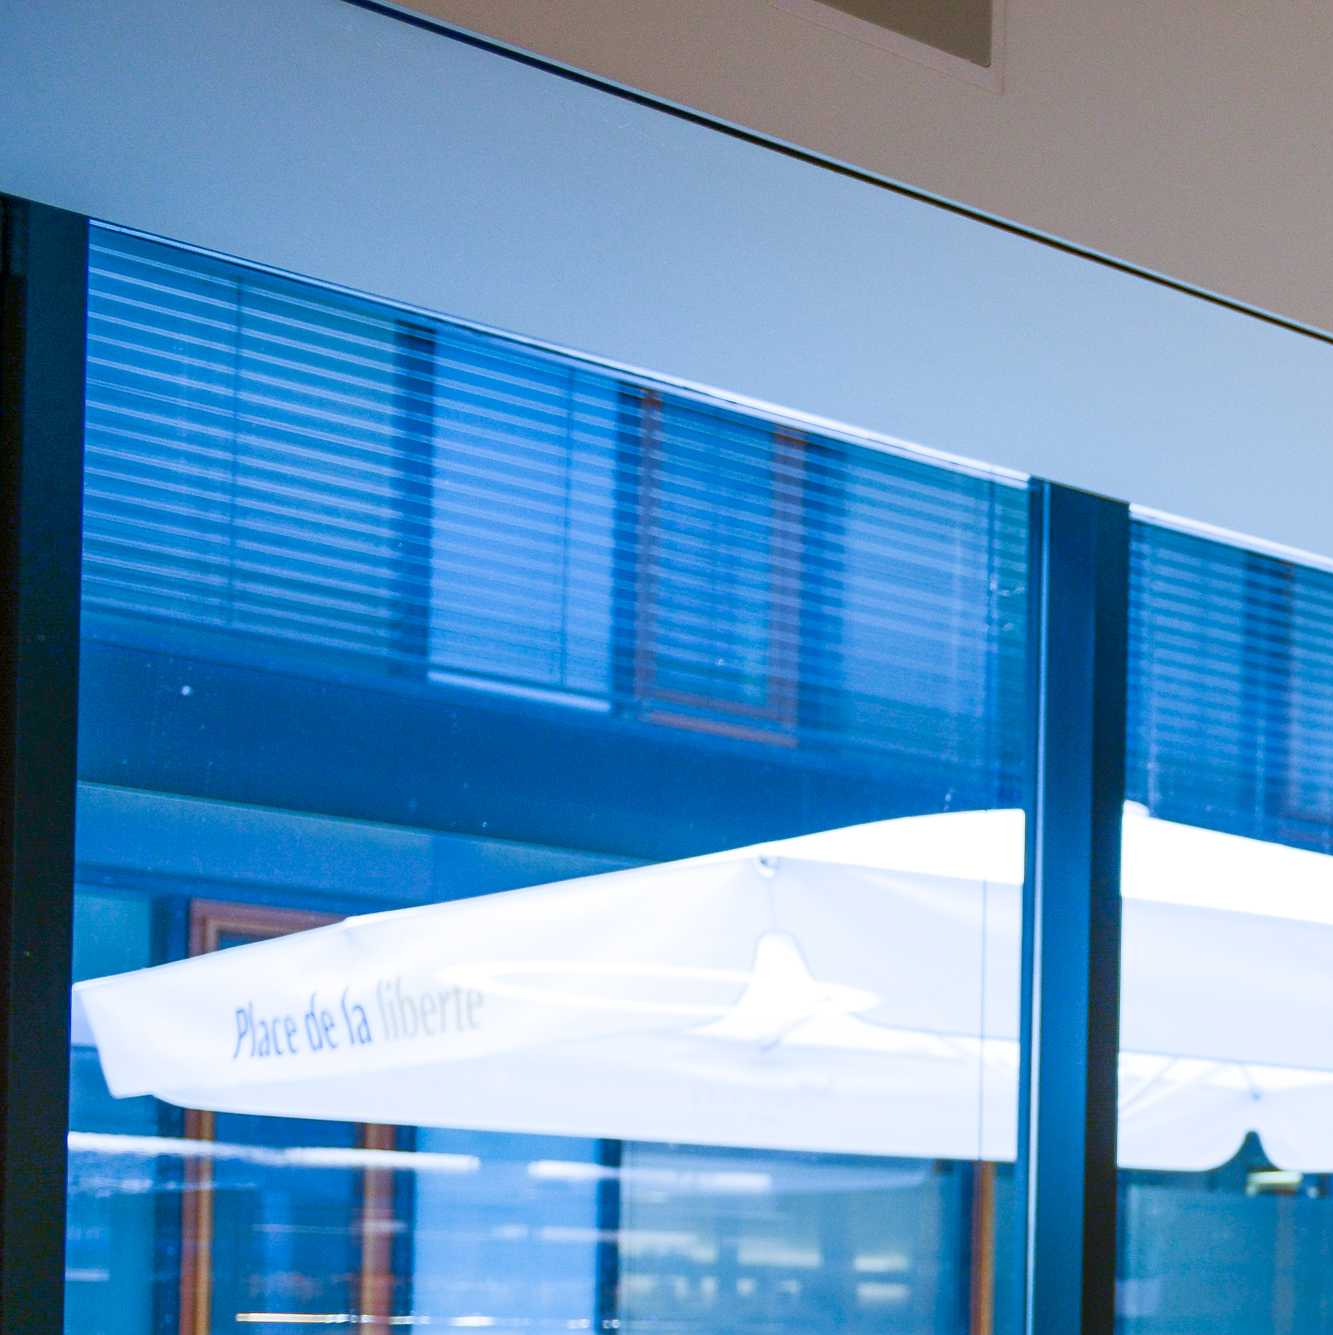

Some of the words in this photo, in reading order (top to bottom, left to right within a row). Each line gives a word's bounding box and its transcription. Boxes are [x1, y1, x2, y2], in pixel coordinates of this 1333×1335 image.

[233, 999, 299, 1060] Place
[304, 991, 338, 1051] de
[341, 985, 373, 1046] la
